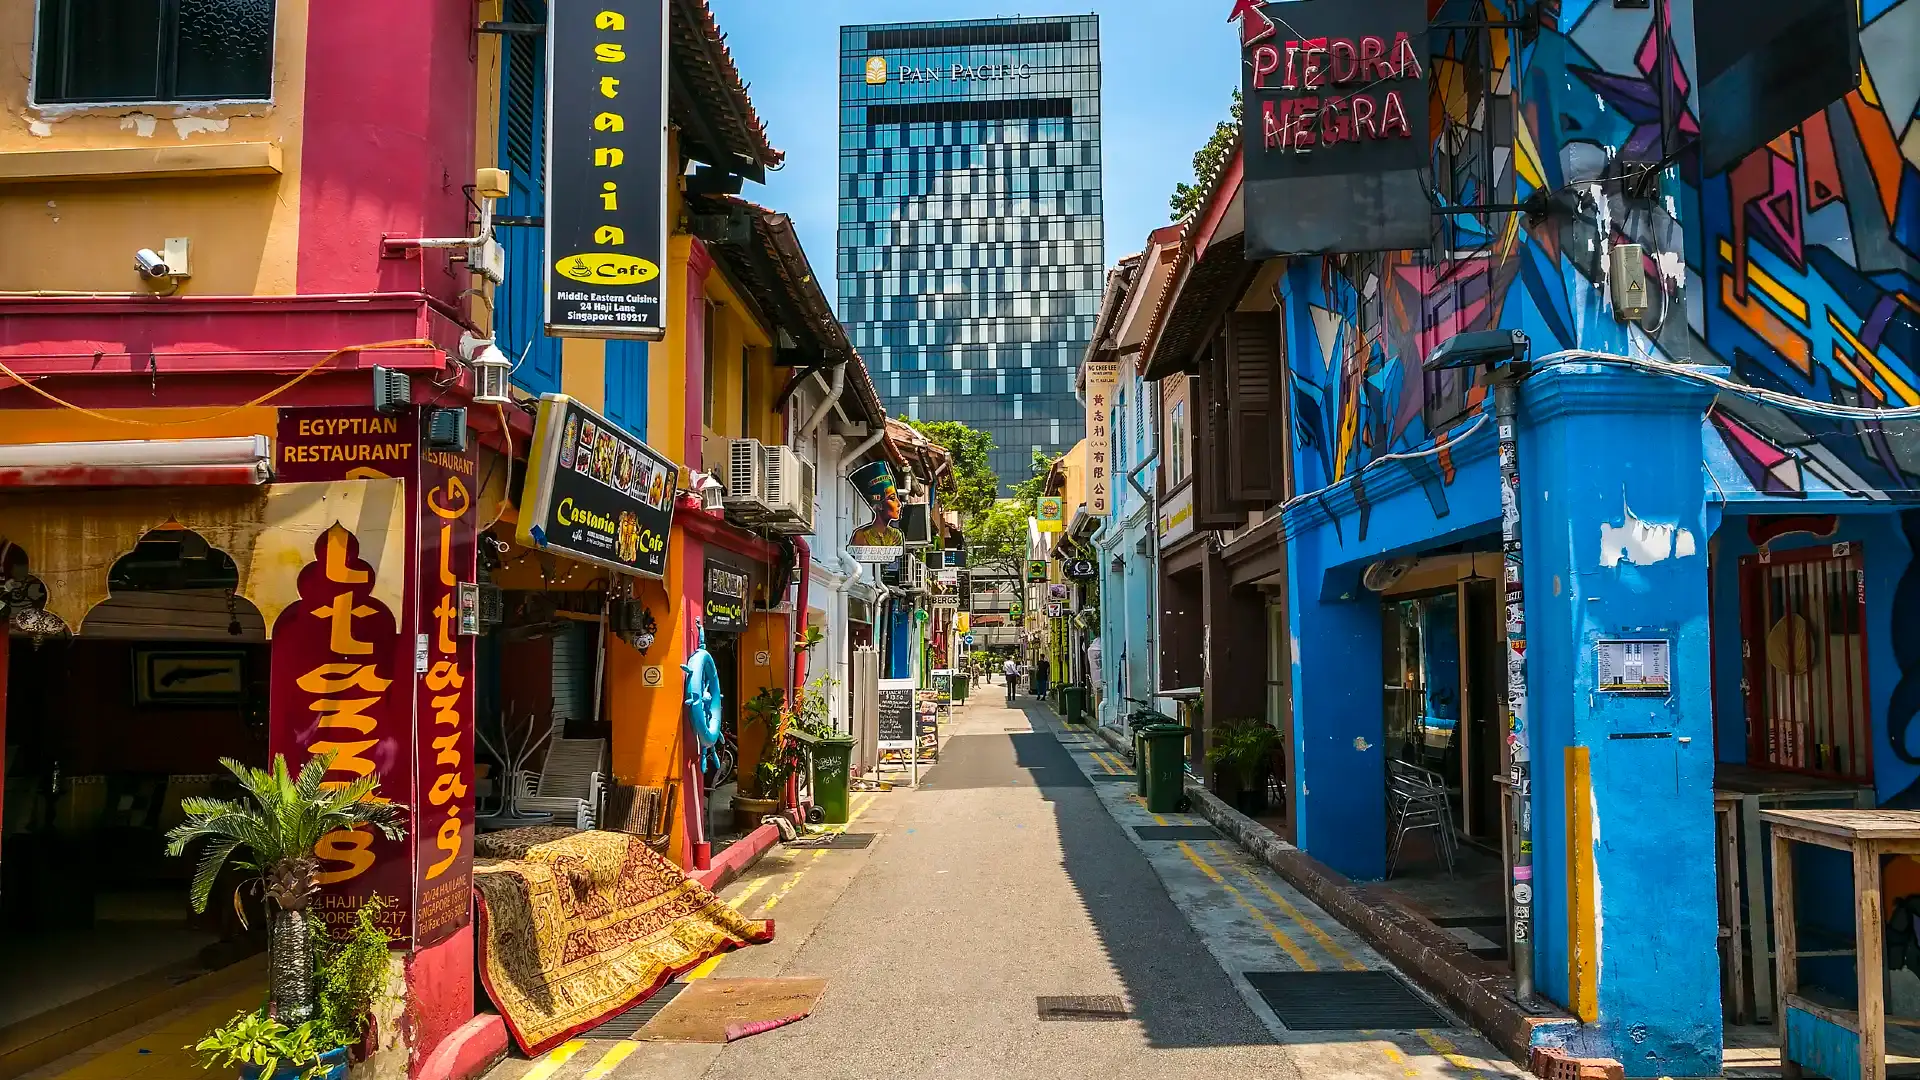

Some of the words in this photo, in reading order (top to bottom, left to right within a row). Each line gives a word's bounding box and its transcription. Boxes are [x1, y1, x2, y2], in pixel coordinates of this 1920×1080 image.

[1252, 32, 1423, 90] PIEDRA
[899, 65, 939, 83] PAN
[951, 63, 1031, 81] PACIFIC
[1262, 92, 1411, 153] NEGRA
[596, 263, 648, 278] Cafe
[557, 292, 589, 301] Middle
[590, 293, 624, 302] Eastern
[626, 294, 658, 304] Cuisine
[580, 303, 592, 311] 24
[594, 303, 612, 313] Haji
[613, 304, 636, 312] Lane
[567, 311, 614, 322] Singapore
[616, 313, 648, 322] 189217
[300, 418, 397, 436] EGYPTIAN
[284, 443, 412, 463] RESTAURANT
[422, 447, 474, 476] RESTAURANT
[557, 497, 615, 535] Castania
[640, 529, 664, 553] Cafe
[932, 596, 958, 604] BERGS
[439, 880, 453, 897] HAJI
[453, 873, 467, 891] LANE
[326, 895, 356, 909] HAJI
[417, 895, 451, 922] SINGAPORE
